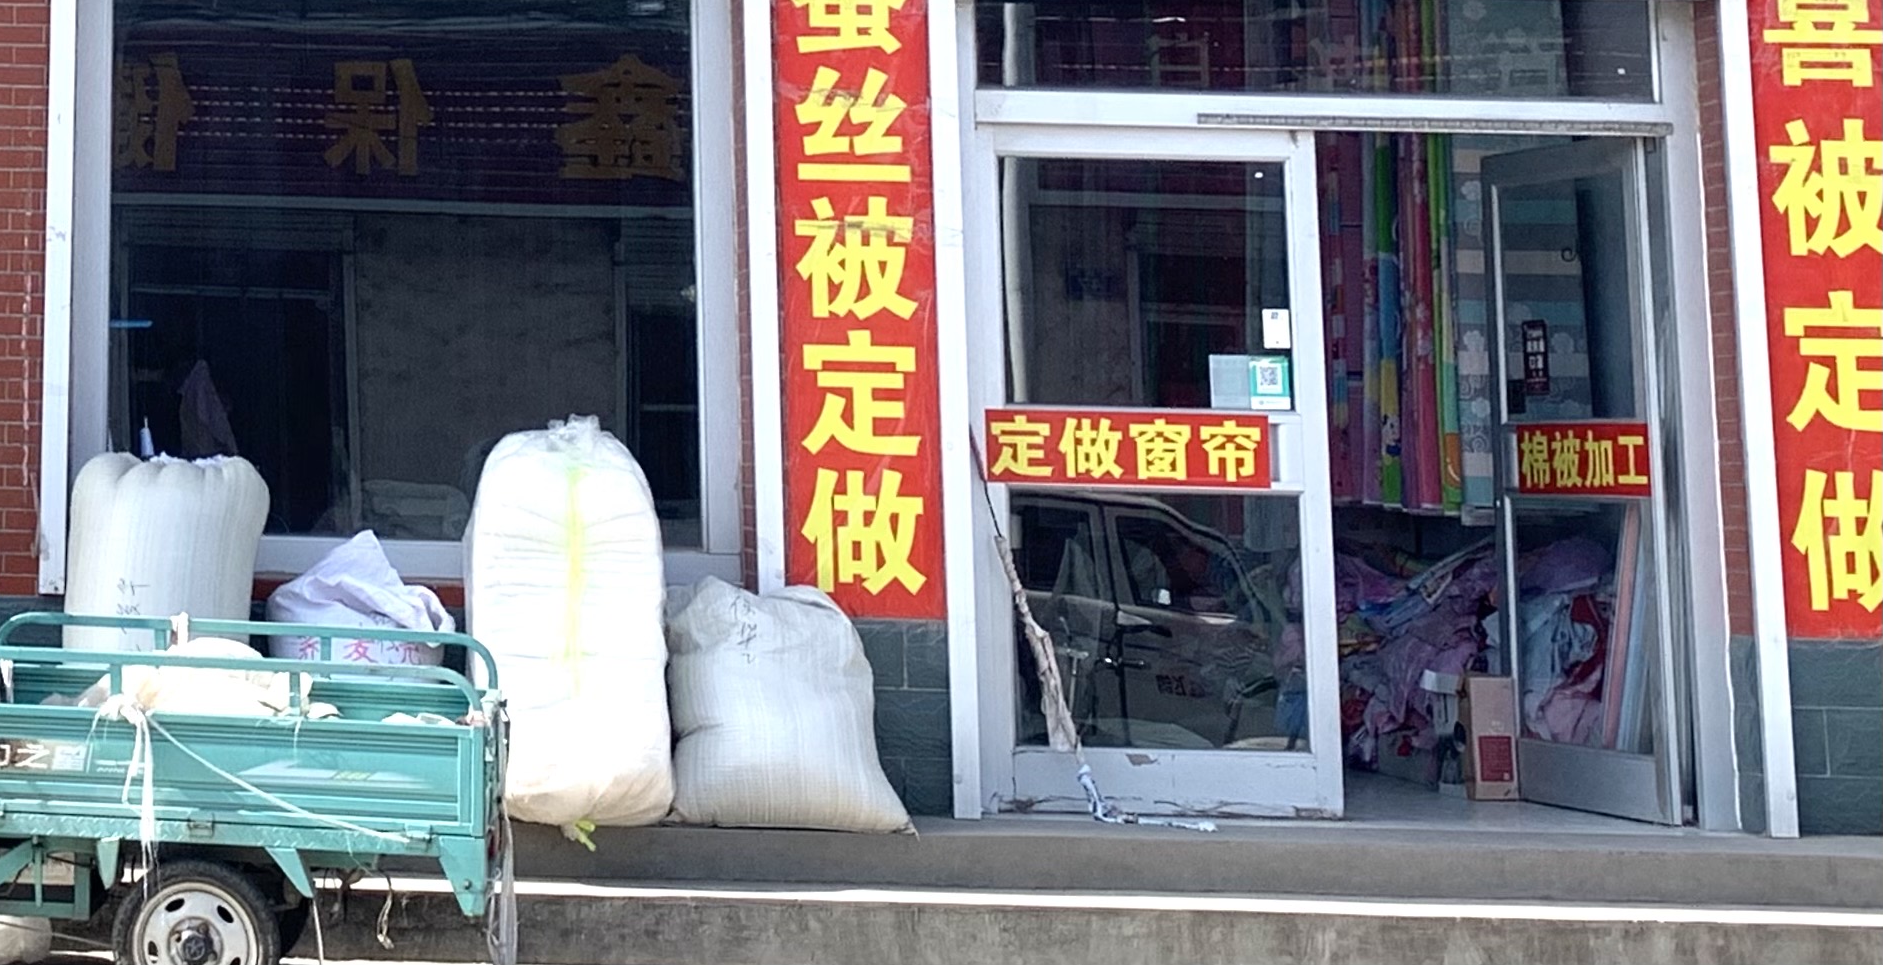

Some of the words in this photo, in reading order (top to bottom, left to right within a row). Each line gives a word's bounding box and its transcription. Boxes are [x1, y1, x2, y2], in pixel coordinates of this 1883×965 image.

[990, 415, 1262, 482] 定做窗帘
[1520, 429, 1649, 489] 棉被加工
